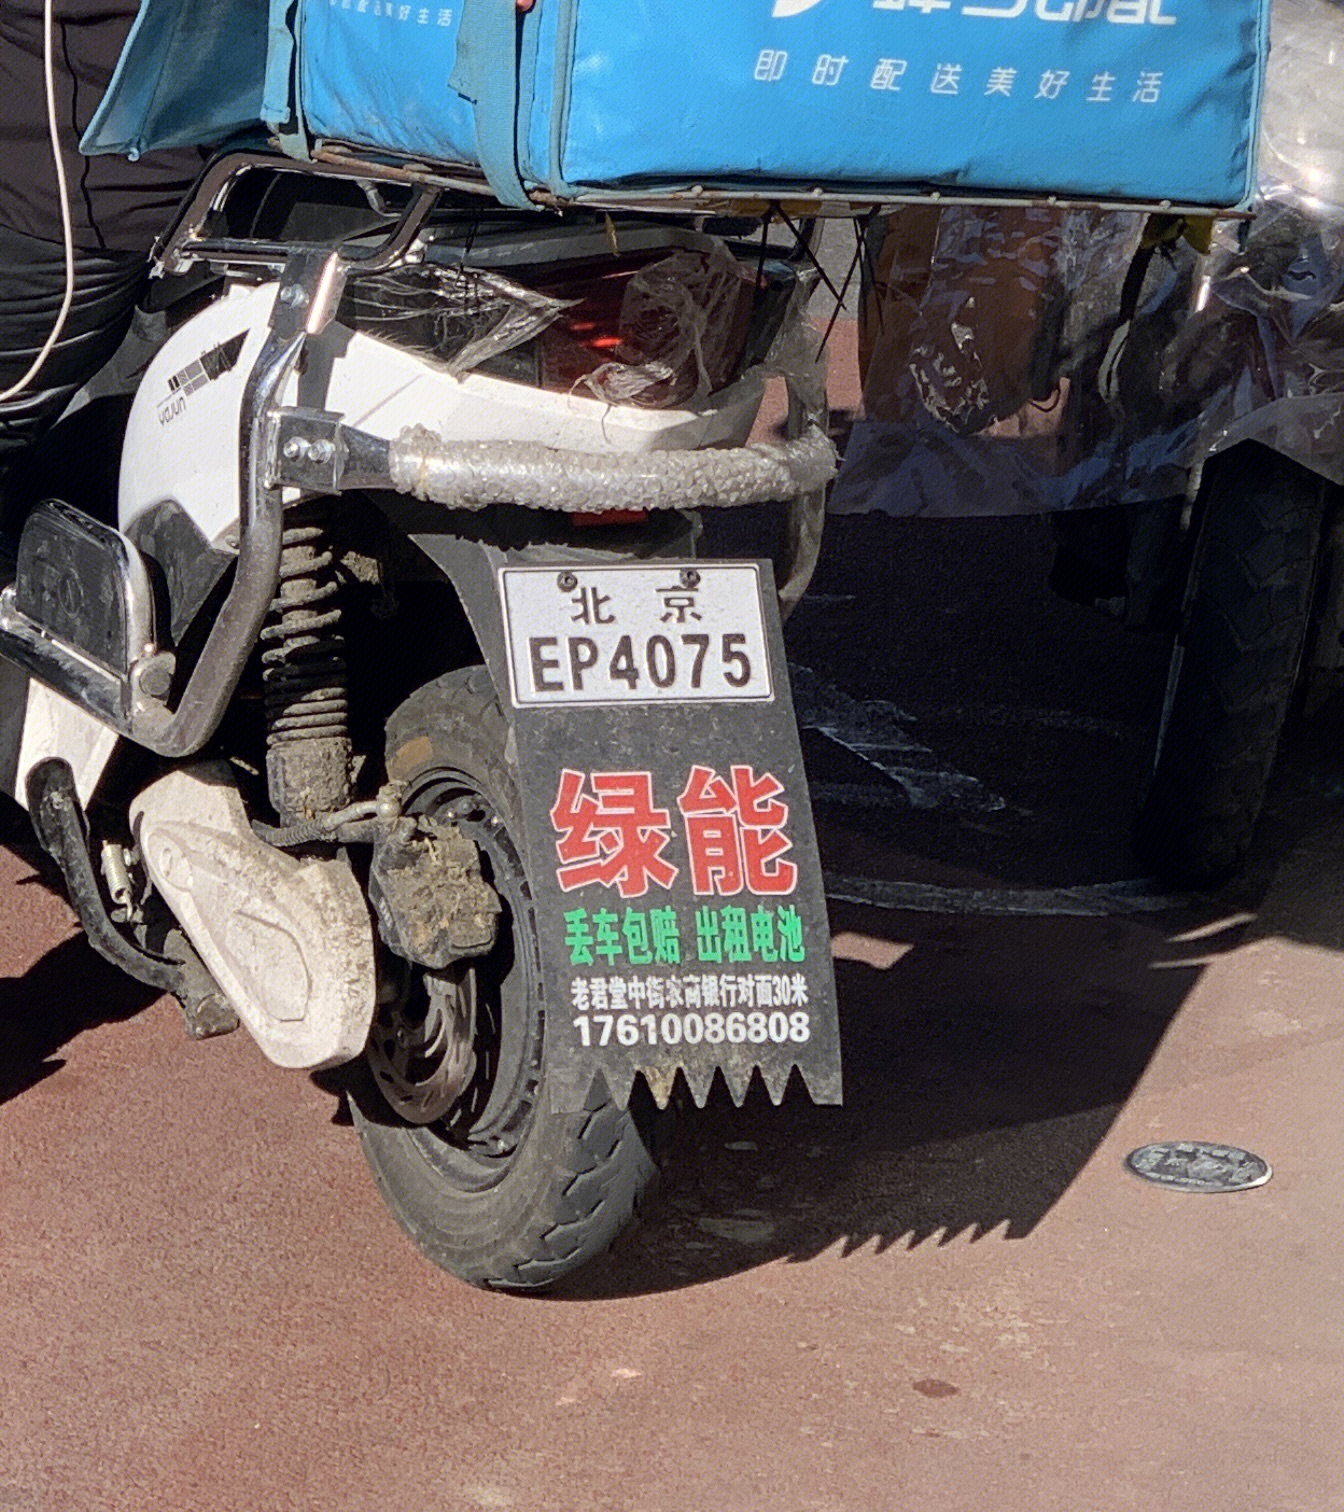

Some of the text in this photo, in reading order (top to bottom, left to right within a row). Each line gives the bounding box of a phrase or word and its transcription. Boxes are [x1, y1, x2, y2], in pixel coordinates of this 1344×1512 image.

[754, 49, 1164, 103] 即时配送美好生活
[571, 586, 703, 625] 北京
[528, 633, 751, 692] EP4075
[550, 764, 798, 898] 绿能
[563, 903, 806, 967] 丢车包赔 出租电池
[573, 1012, 810, 1047] 17610086808
